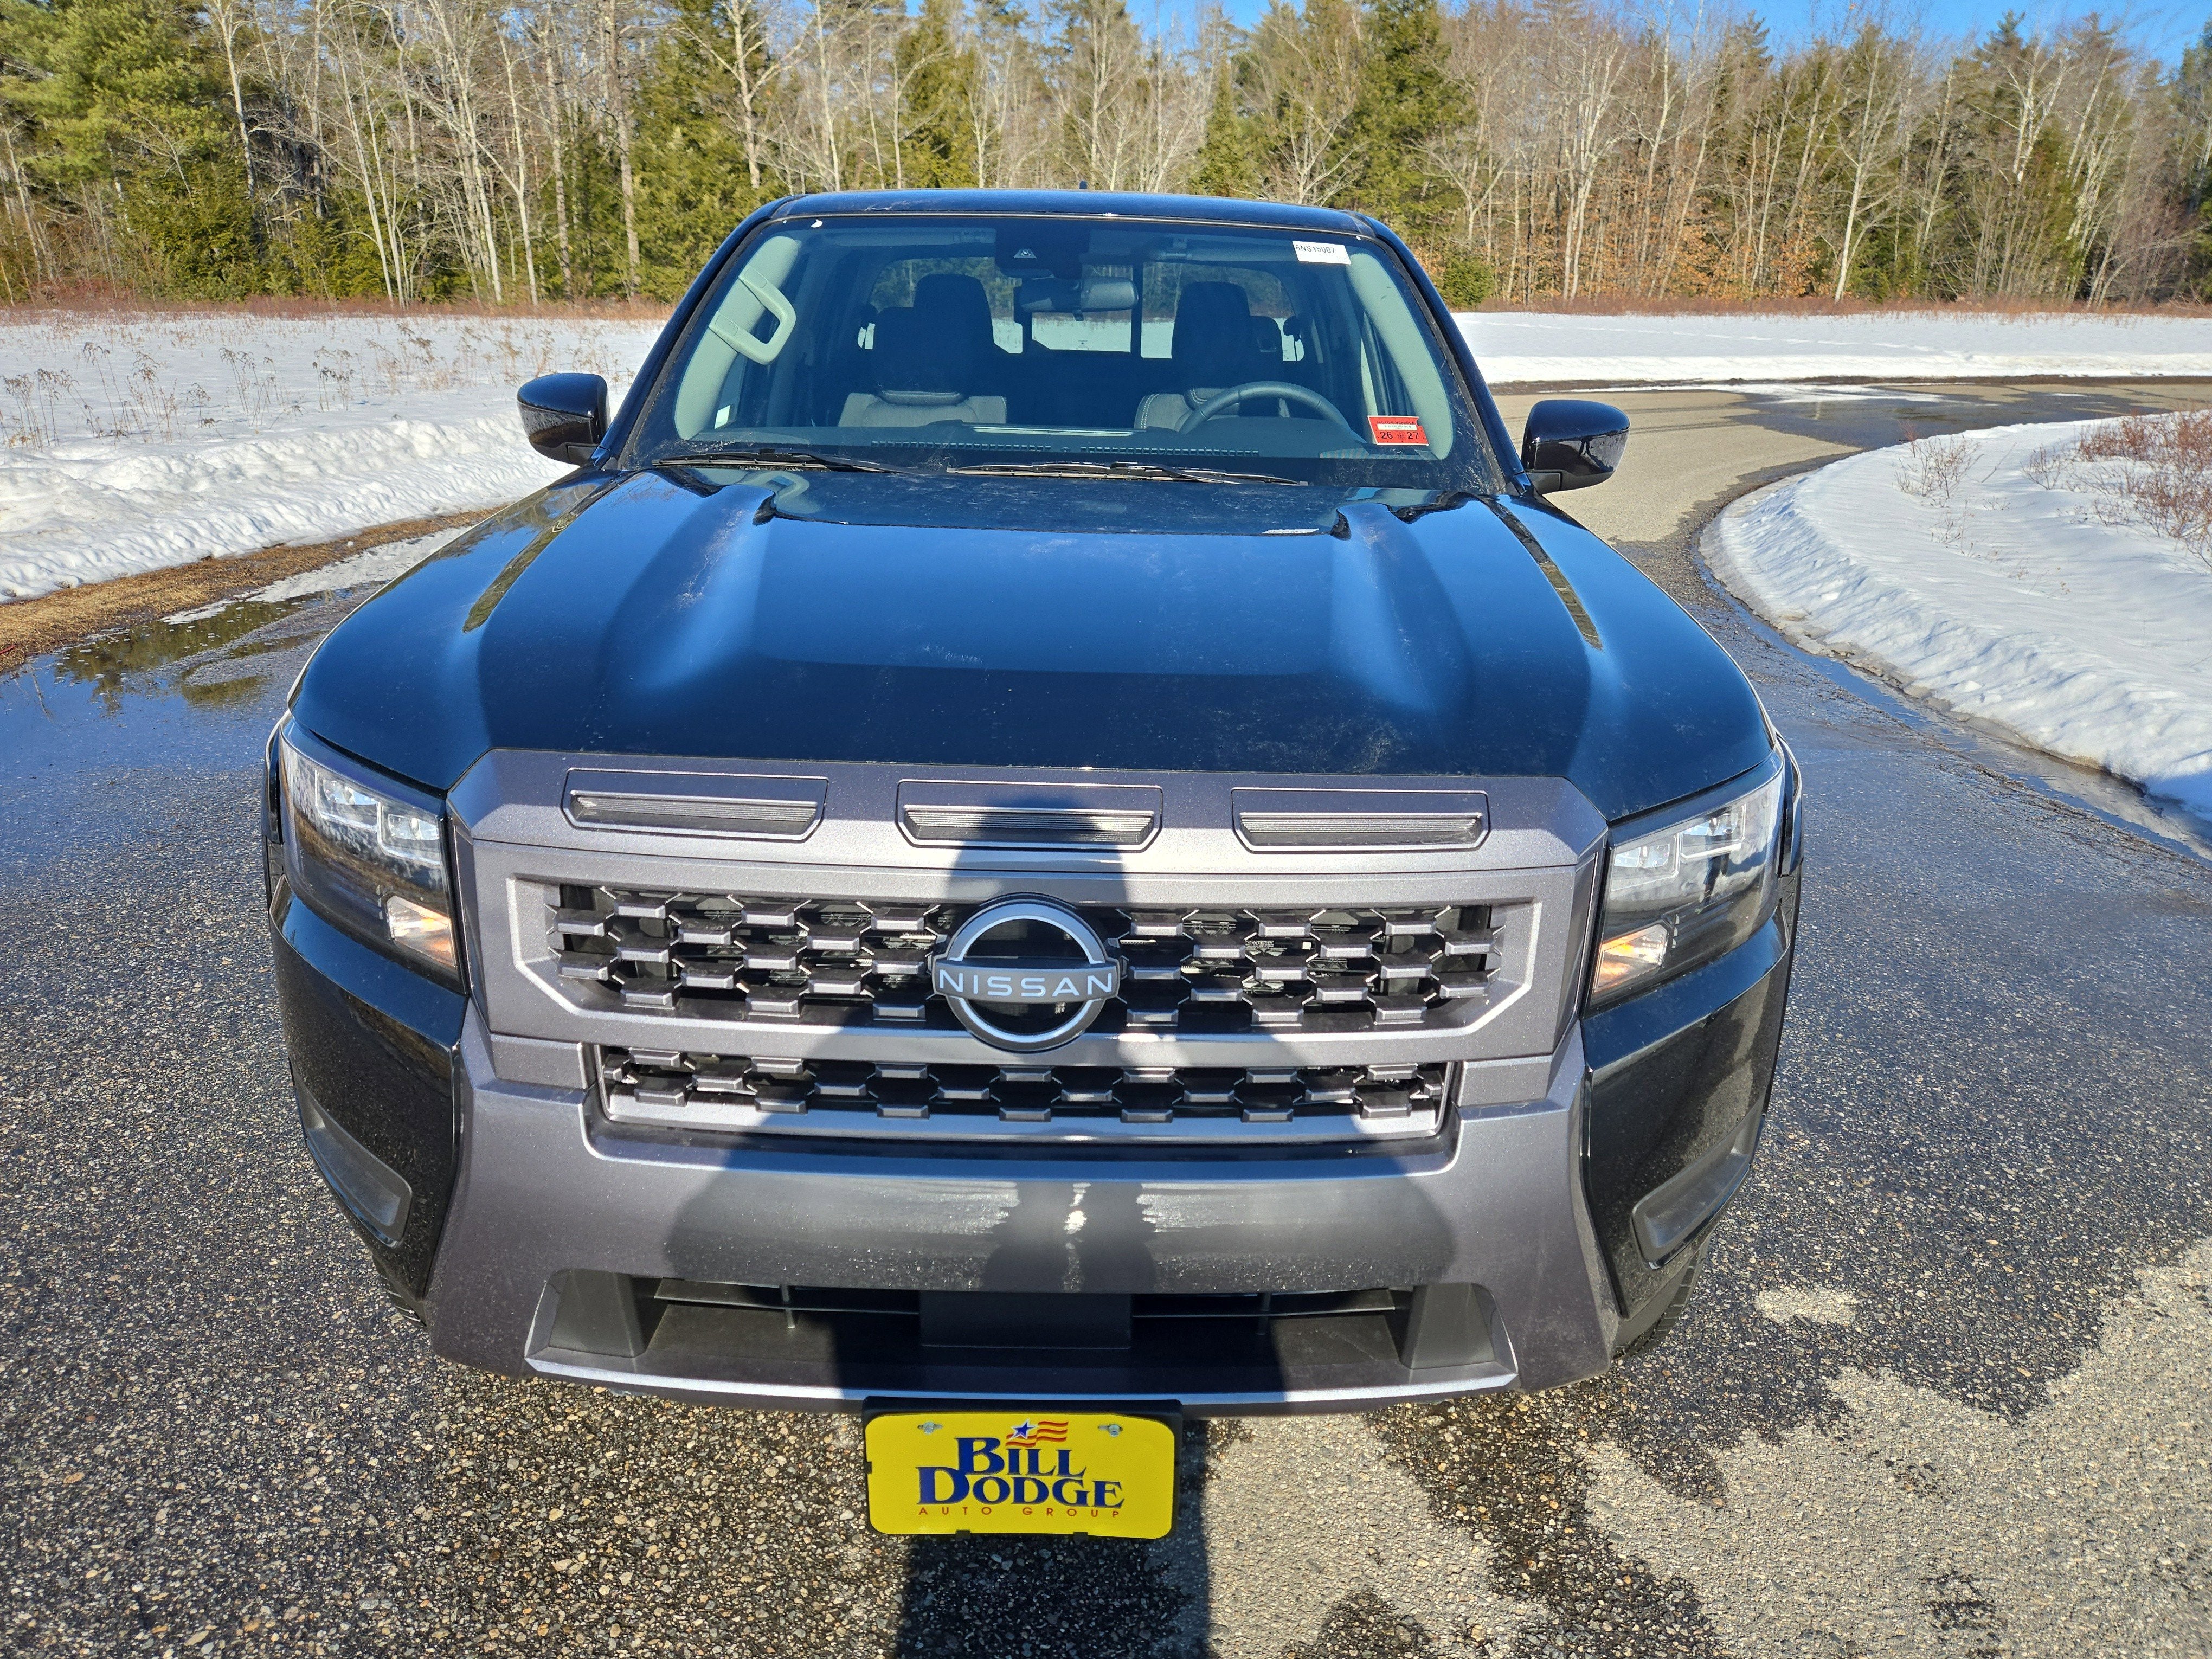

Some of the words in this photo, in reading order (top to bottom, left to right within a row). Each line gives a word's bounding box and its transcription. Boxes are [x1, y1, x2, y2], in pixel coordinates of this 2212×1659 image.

[1295, 245, 1335, 254] 6NS15007
[1380, 431, 1393, 439] 26
[939, 969, 1112, 997] NISSAN
[955, 1437, 1087, 1478] BILL
[915, 1466, 1126, 1509] DODGE
[918, 1506, 992, 1516] AUTO
[1022, 1507, 1120, 1519] GROUP
